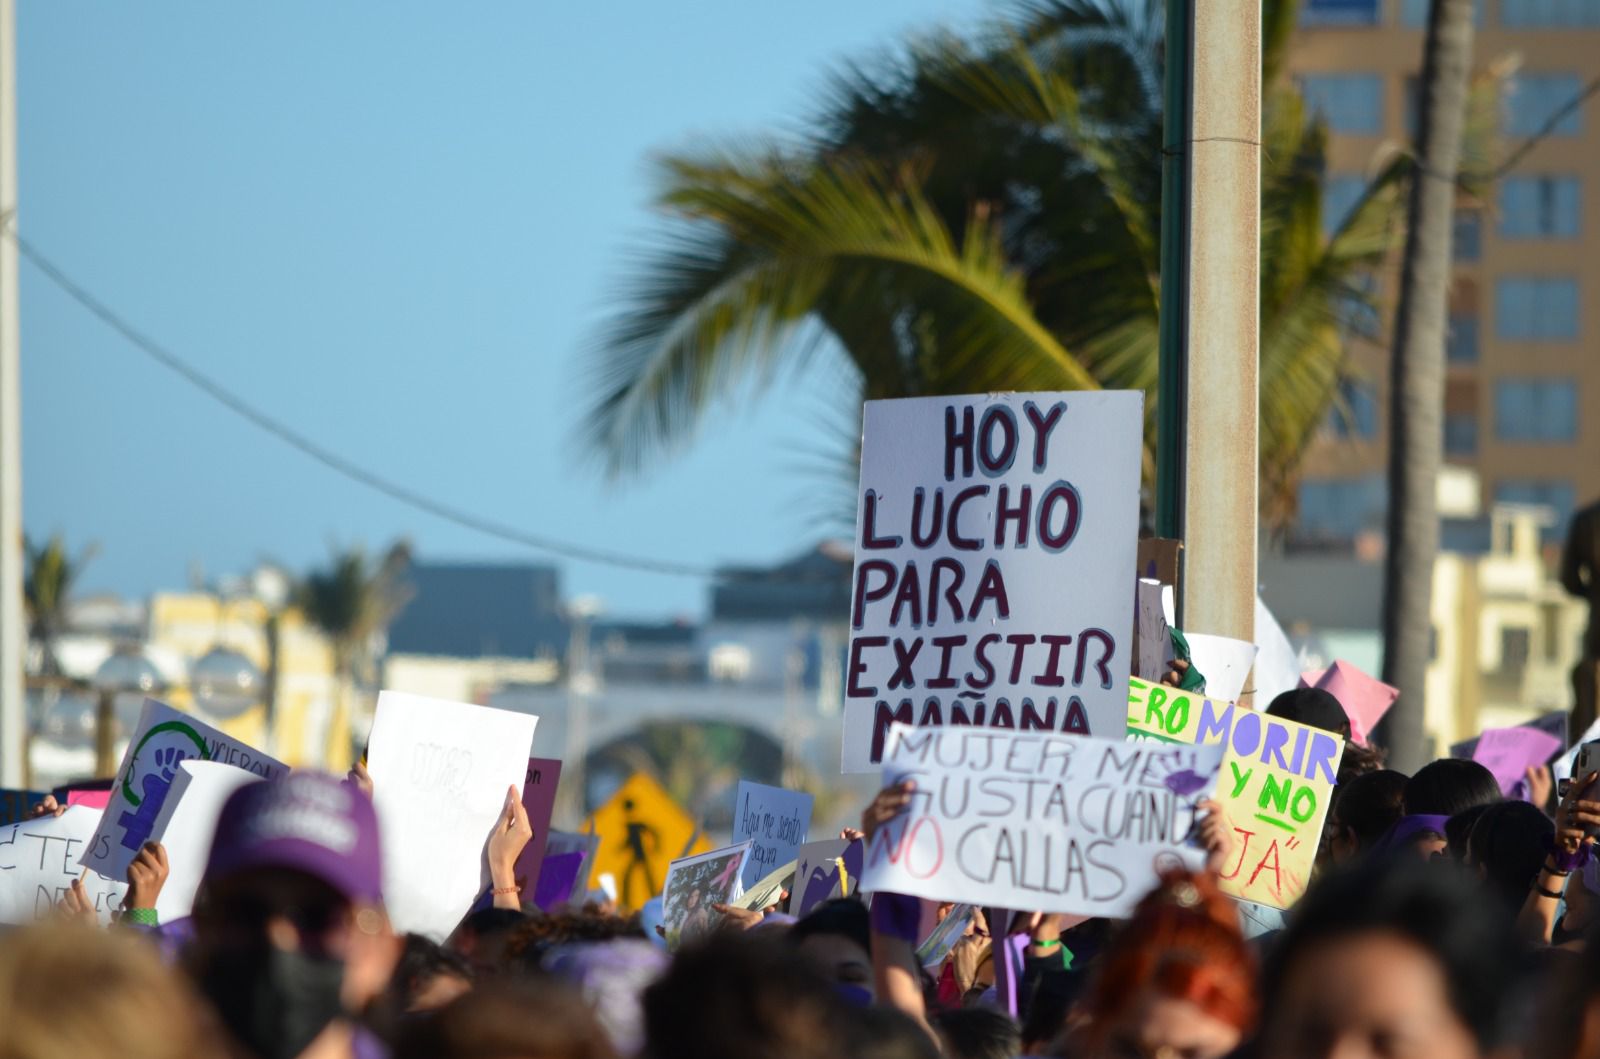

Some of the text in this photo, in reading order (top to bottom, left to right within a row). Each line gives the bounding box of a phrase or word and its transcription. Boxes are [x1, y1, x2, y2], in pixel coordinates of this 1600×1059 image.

[944, 400, 1067, 482] HOY
[862, 479, 1083, 554] LUCHO
[852, 557, 1010, 630] PARA
[847, 628, 1115, 698] EXISTIR
[890, 731, 1172, 790] MUJER ME
[1127, 679, 1338, 786] ERO MORIR
[1077, 782, 1209, 846] CUAND
[1230, 761, 1317, 824] Y NO
[869, 814, 1127, 901] NO CALLAS
